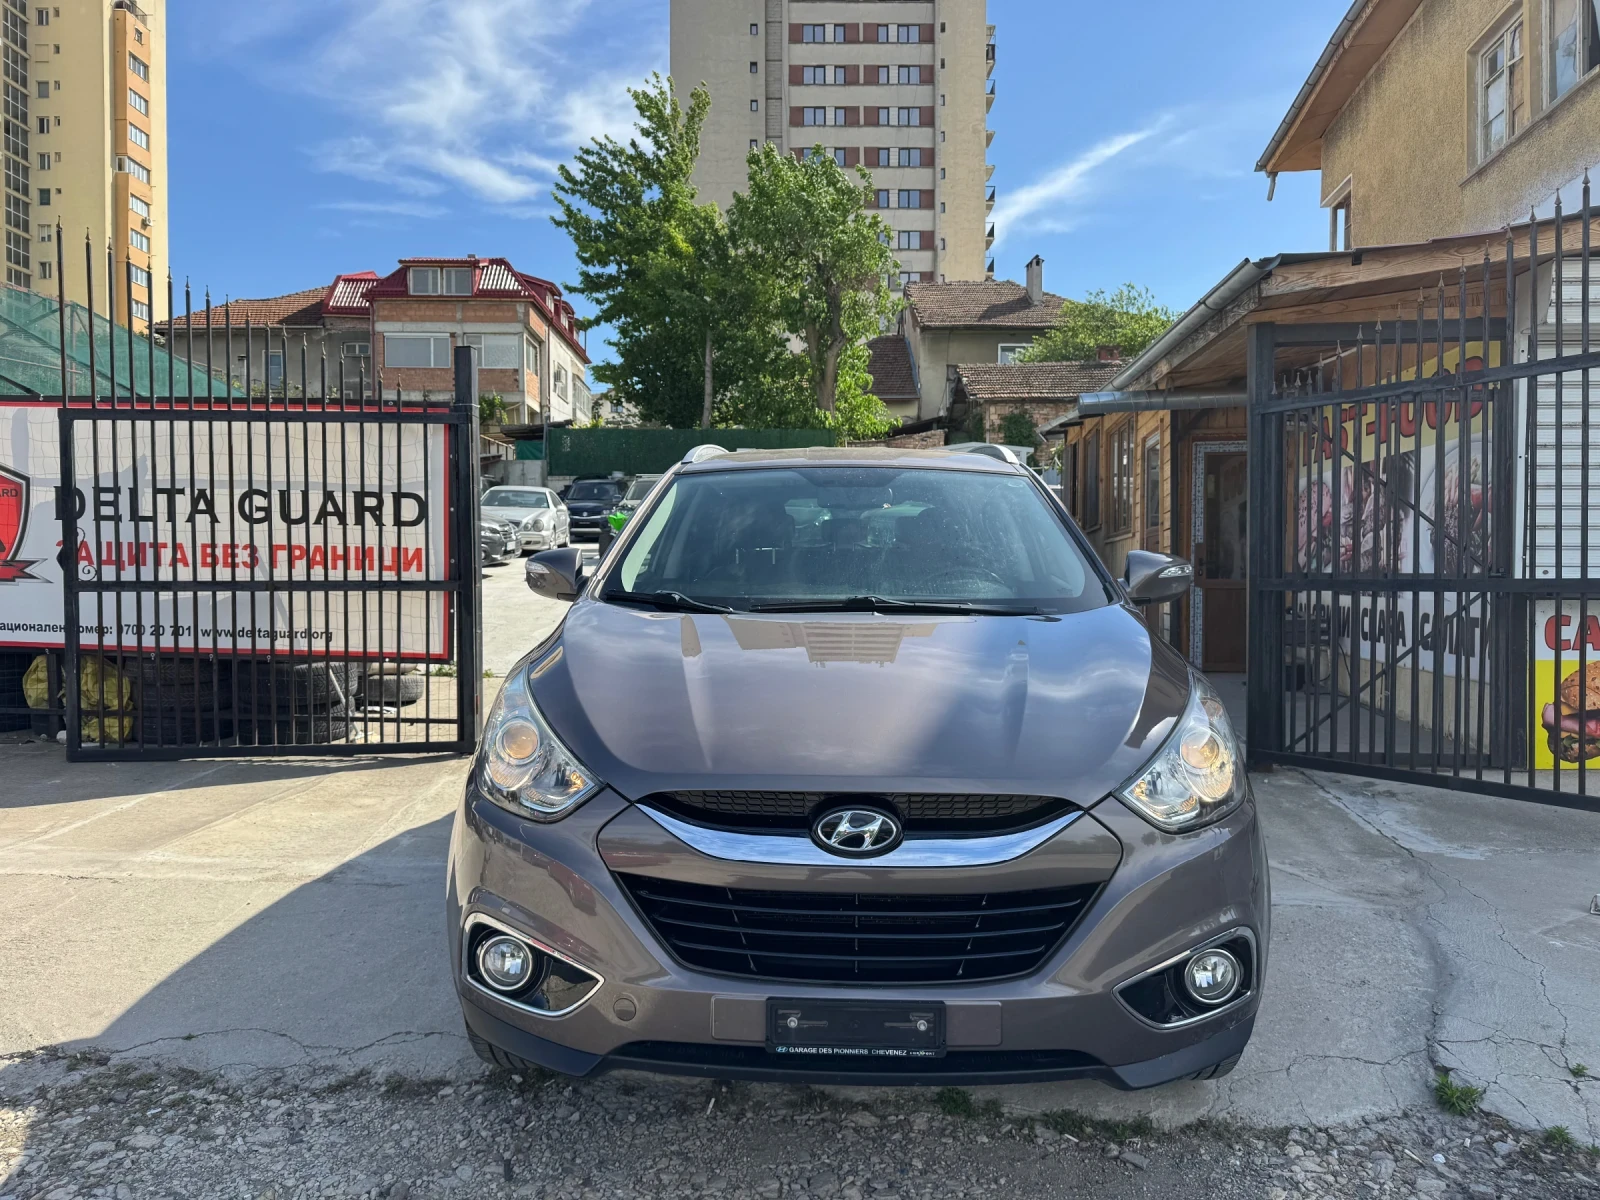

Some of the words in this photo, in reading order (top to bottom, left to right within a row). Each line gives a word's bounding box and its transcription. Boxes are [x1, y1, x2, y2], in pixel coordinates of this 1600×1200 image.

[0, 488, 19, 498] RD
[237, 488, 427, 527] GUARD
[55, 539, 190, 572] АЩИТА
[200, 542, 260, 569] БЕЗ
[271, 544, 423, 577] ГРАНИЦИ
[73, 624, 113, 637] омер:
[150, 625, 165, 637] 20
[169, 625, 192, 637] 701
[200, 626, 333, 643] wwwdetaguardorg
[789, 1046, 818, 1054] GARAGE
[871, 1048, 907, 1056] CHEVENEZ
